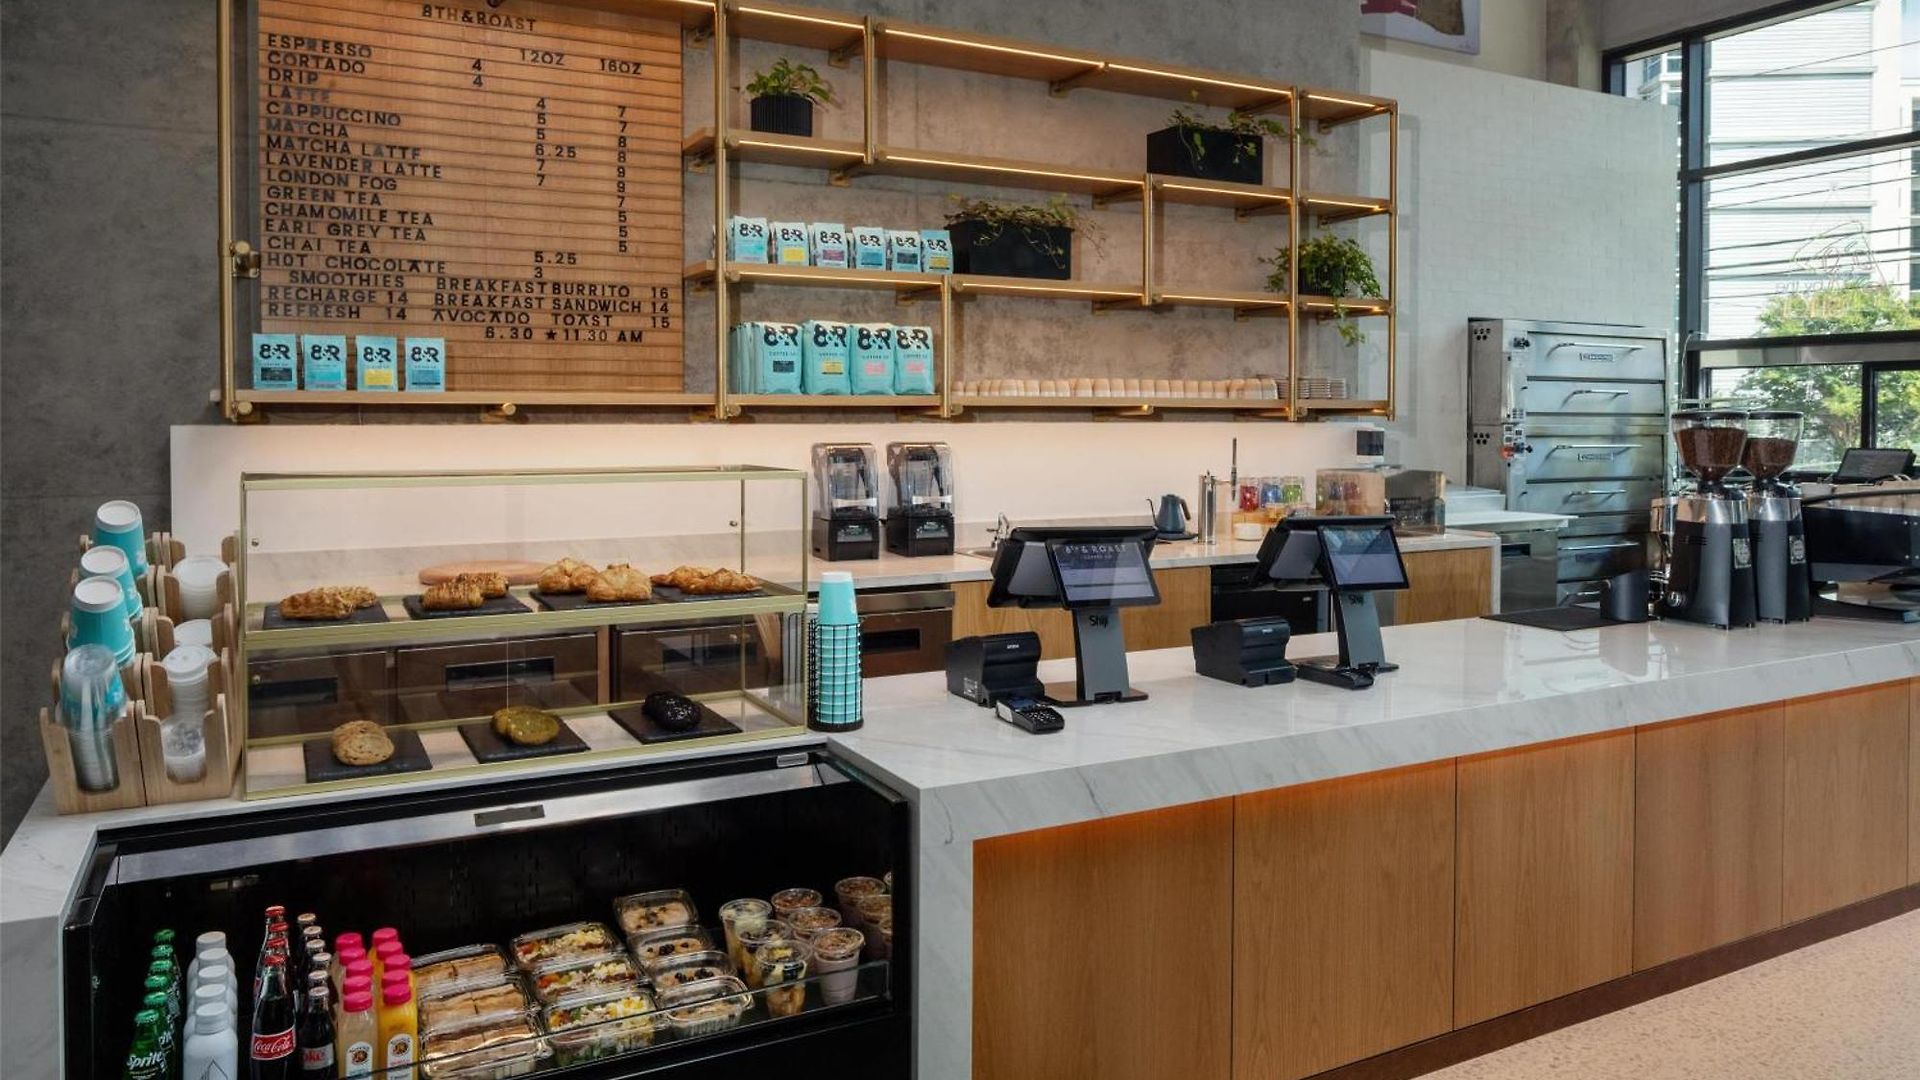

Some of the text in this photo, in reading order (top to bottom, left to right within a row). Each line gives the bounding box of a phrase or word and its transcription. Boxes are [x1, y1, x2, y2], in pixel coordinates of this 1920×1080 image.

[267, 33, 483, 72] ESPRESSO 4
[519, 48, 642, 75] 12OZ 16OZ
[267, 50, 483, 88] CORTADO 4
[268, 67, 627, 118] DRIP 4 7
[266, 101, 627, 148] CAPPUCCINO 5 8
[537, 113, 546, 125] 5
[618, 121, 628, 133] 7
[266, 117, 626, 163] MATCHA 6.25 8
[266, 135, 351, 154] MATCHA
[536, 159, 545, 171] 7
[616, 166, 626, 178] 9
[266, 151, 626, 193] LAVENDER LATTE 7 9
[267, 168, 626, 208] LONDON FOG 7
[267, 185, 627, 223] GREEN TEA 5
[265, 202, 628, 238] CHAMOMILE TEA 5
[265, 218, 627, 253] EARL GREY TEA 5
[267, 235, 577, 265] CHAI TEA 5.25
[268, 252, 543, 279] HOT CHOCOLATE 3
[289, 270, 405, 288] SMOOTHIES
[268, 287, 409, 305] RECHARGE 14
[434, 292, 668, 314] BREAKFAST SANDWICH 14
[436, 277, 668, 300] BREAKFAST BURRITO 16
[268, 302, 407, 321] REFRESH 14
[433, 308, 670, 329] AVOCADO TOAST 15
[616, 330, 643, 343] AM
[126, 1051, 163, 1071] Sprite
